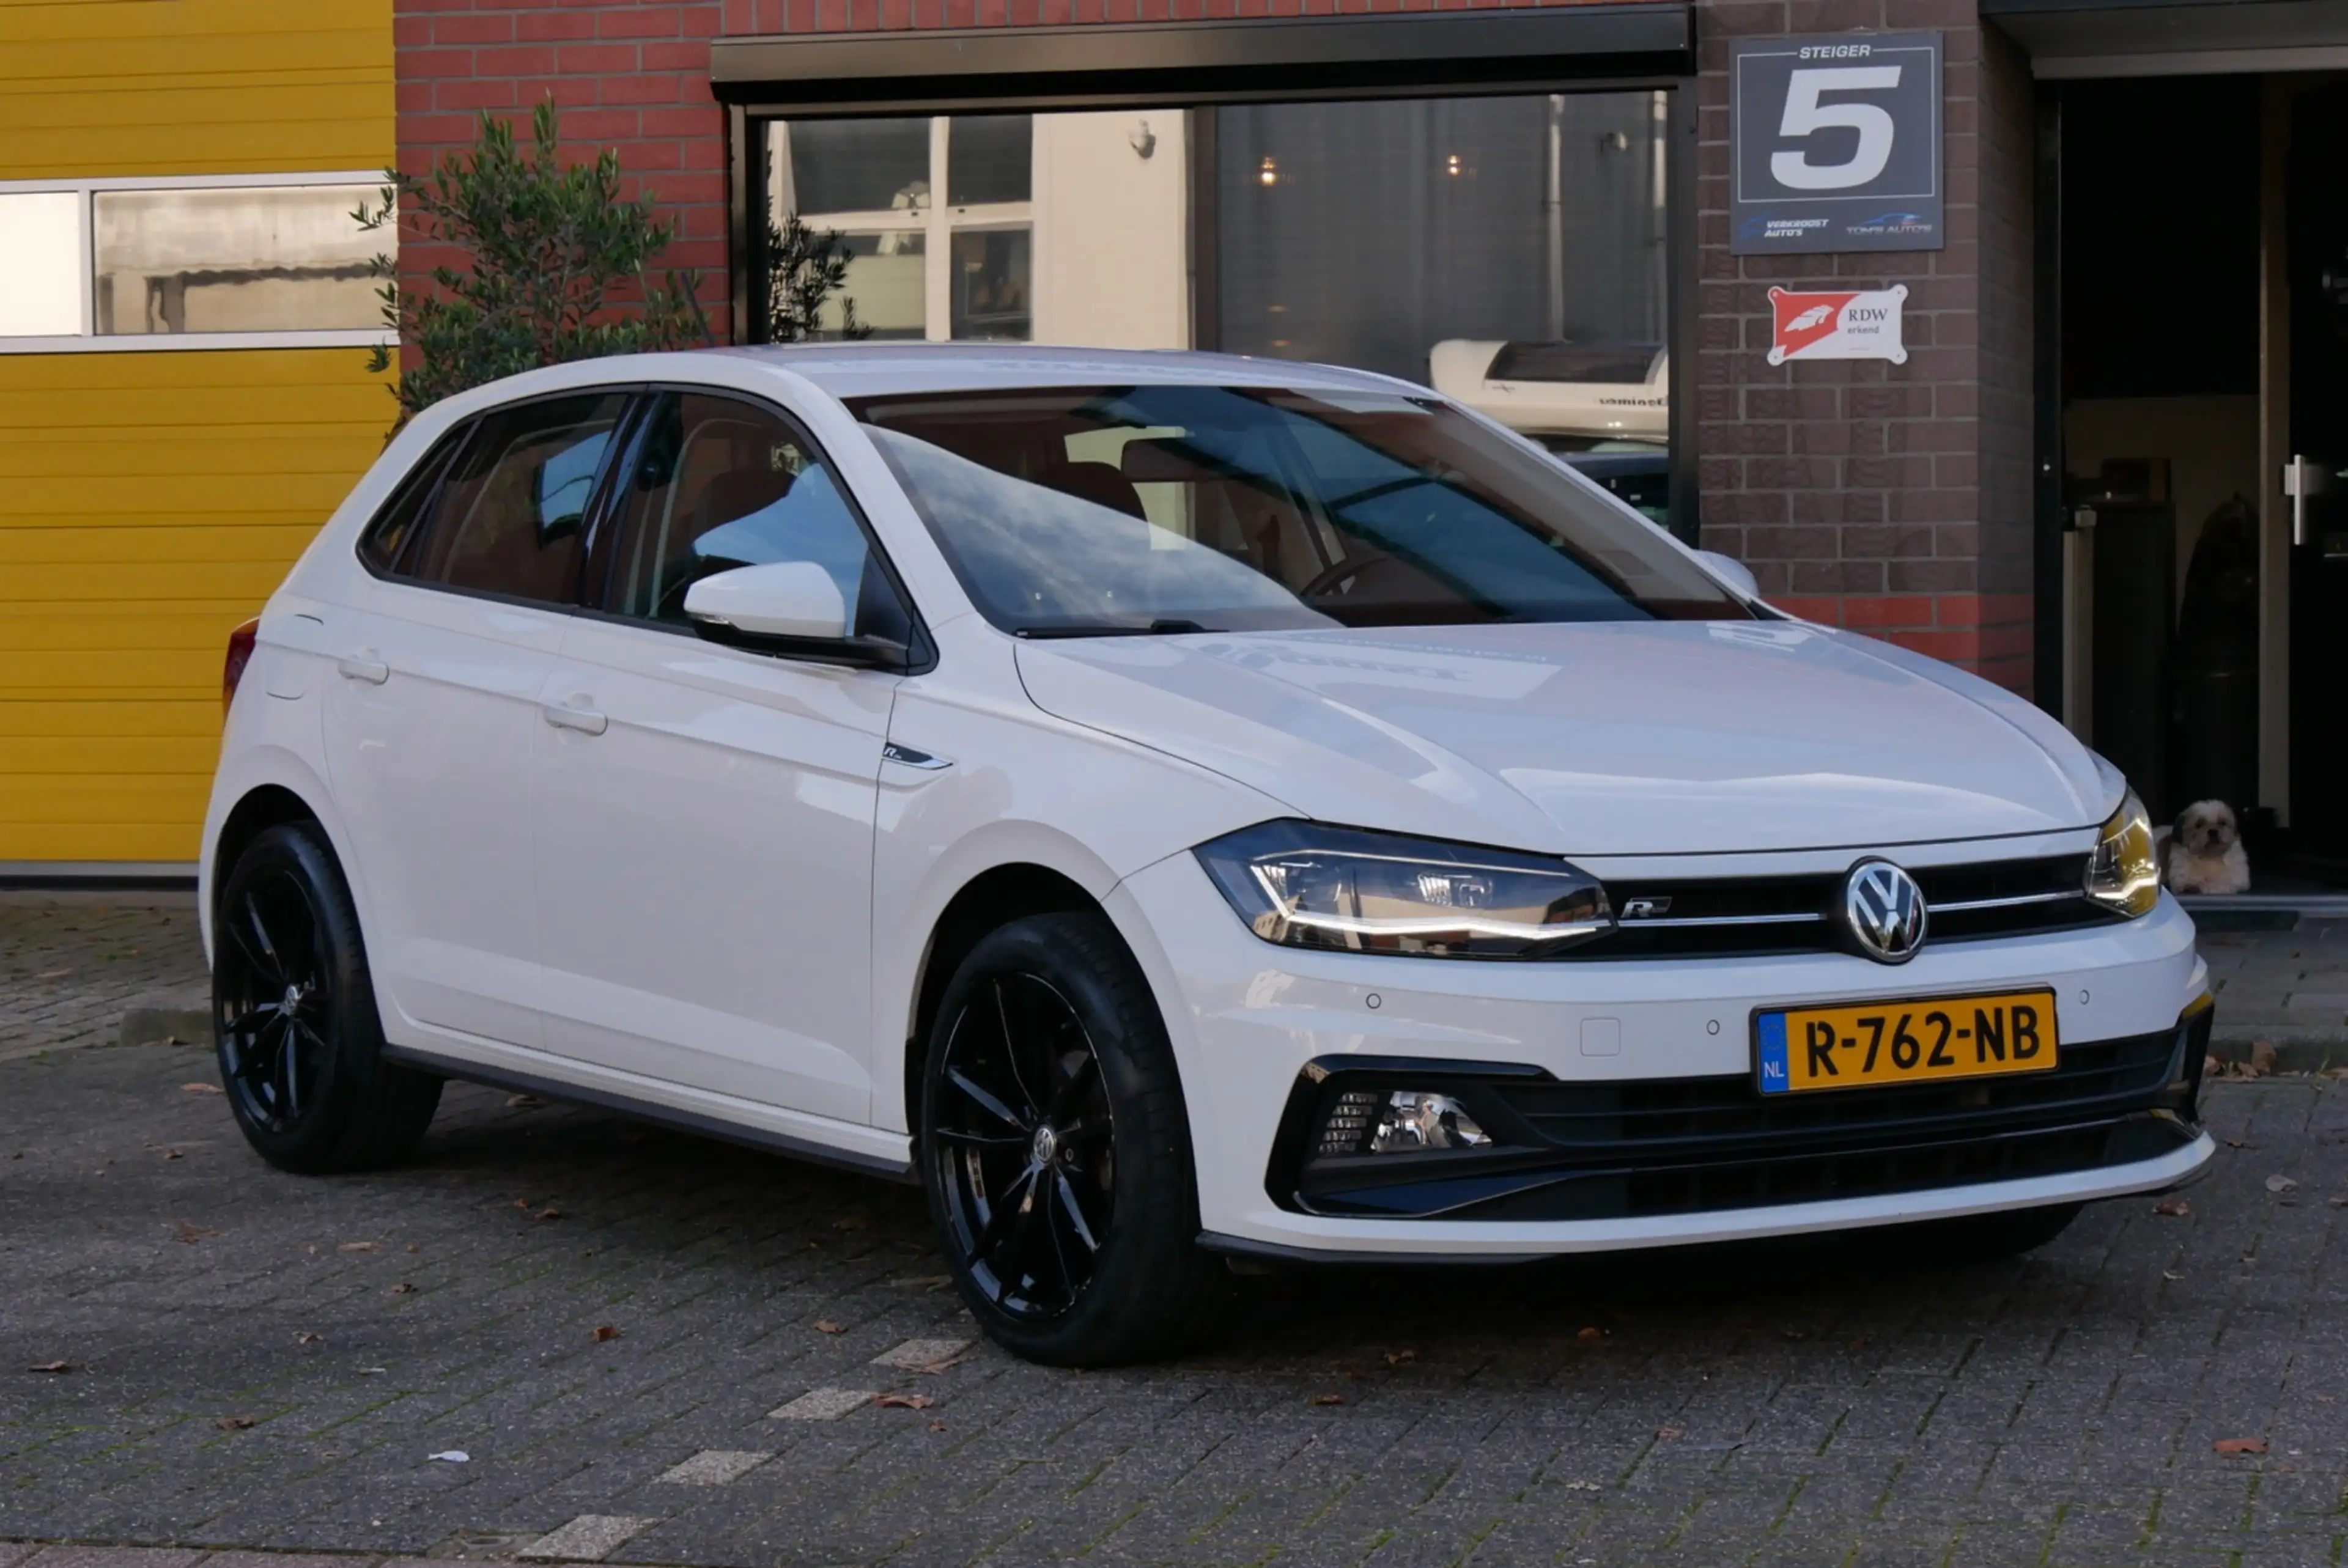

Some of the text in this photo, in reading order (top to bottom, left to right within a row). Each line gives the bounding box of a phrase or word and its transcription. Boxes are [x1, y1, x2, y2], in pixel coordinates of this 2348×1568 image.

[1799, 45, 1871, 59] STEIGER
[1770, 65, 1902, 190] 5
[1767, 218, 1830, 229] VERKROOST
[1764, 228, 1803, 238] AUTO'S
[1848, 308, 1888, 322] RDW
[1847, 325, 1880, 334] erkend
[1806, 1005, 2040, 1078] R-762-NB
[1764, 1061, 1784, 1079] NL
